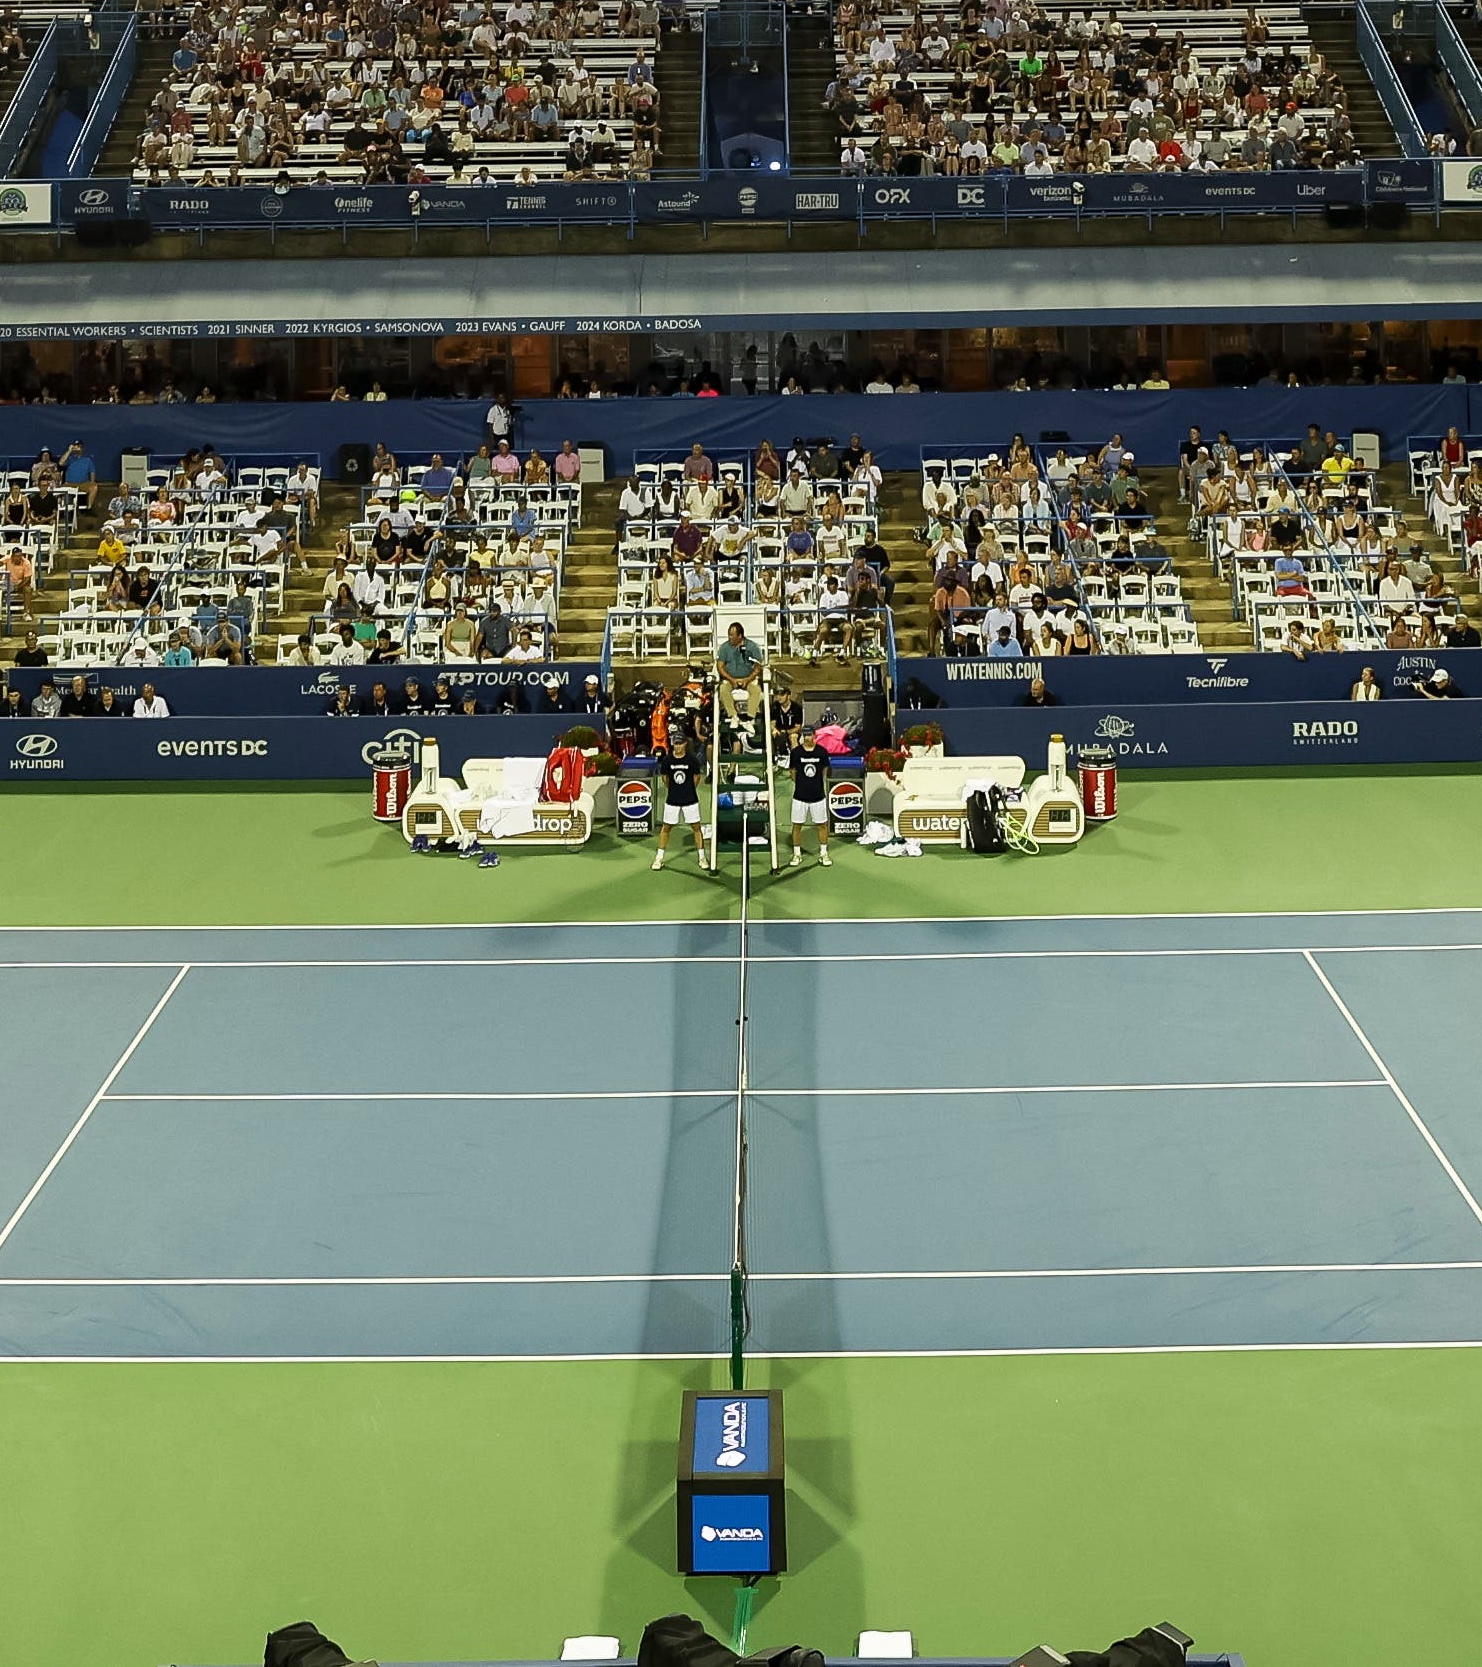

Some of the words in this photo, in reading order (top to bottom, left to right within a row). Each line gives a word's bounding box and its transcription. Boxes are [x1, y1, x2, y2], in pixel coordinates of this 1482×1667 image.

[1030, 186, 1071, 196] verizon
[1297, 184, 1326, 196] Uber
[169, 200, 209, 210] RADO
[658, 198, 691, 209] Astound
[796, 194, 839, 208] HAR-TRU
[74, 206, 114, 215] HYUNDAI
[16, 326, 70, 337] ESSENTIAL
[72, 326, 126, 336] WORKERS
[139, 325, 198, 335] SCIENTISTS
[207, 325, 230, 334] 2021
[235, 324, 275, 334] SINNER
[285, 323, 309, 333] 2022
[313, 323, 361, 333] KYRGIOS
[375, 322, 444, 332] SAMSONOVA
[455, 322, 478, 332] 2023
[482, 322, 517, 332] EVANS
[529, 321, 566, 331] GAUFF
[576, 321, 600, 331] 2024
[602, 320, 642, 331] KORDA
[654, 319, 702, 330] BADOSA
[1396, 655, 1437, 671] AUSTIN
[946, 662, 1042, 680] WTATENNIS.COM
[1186, 676, 1249, 688] Tecnifibre
[301, 684, 356, 695] LACOSE
[1292, 721, 1358, 738] RADO
[240, 740, 268, 756] DC
[10, 759, 64, 769] HYUNDAI
[723, 1401, 740, 1452] VANDA
[716, 1528, 763, 1538] VANDA
